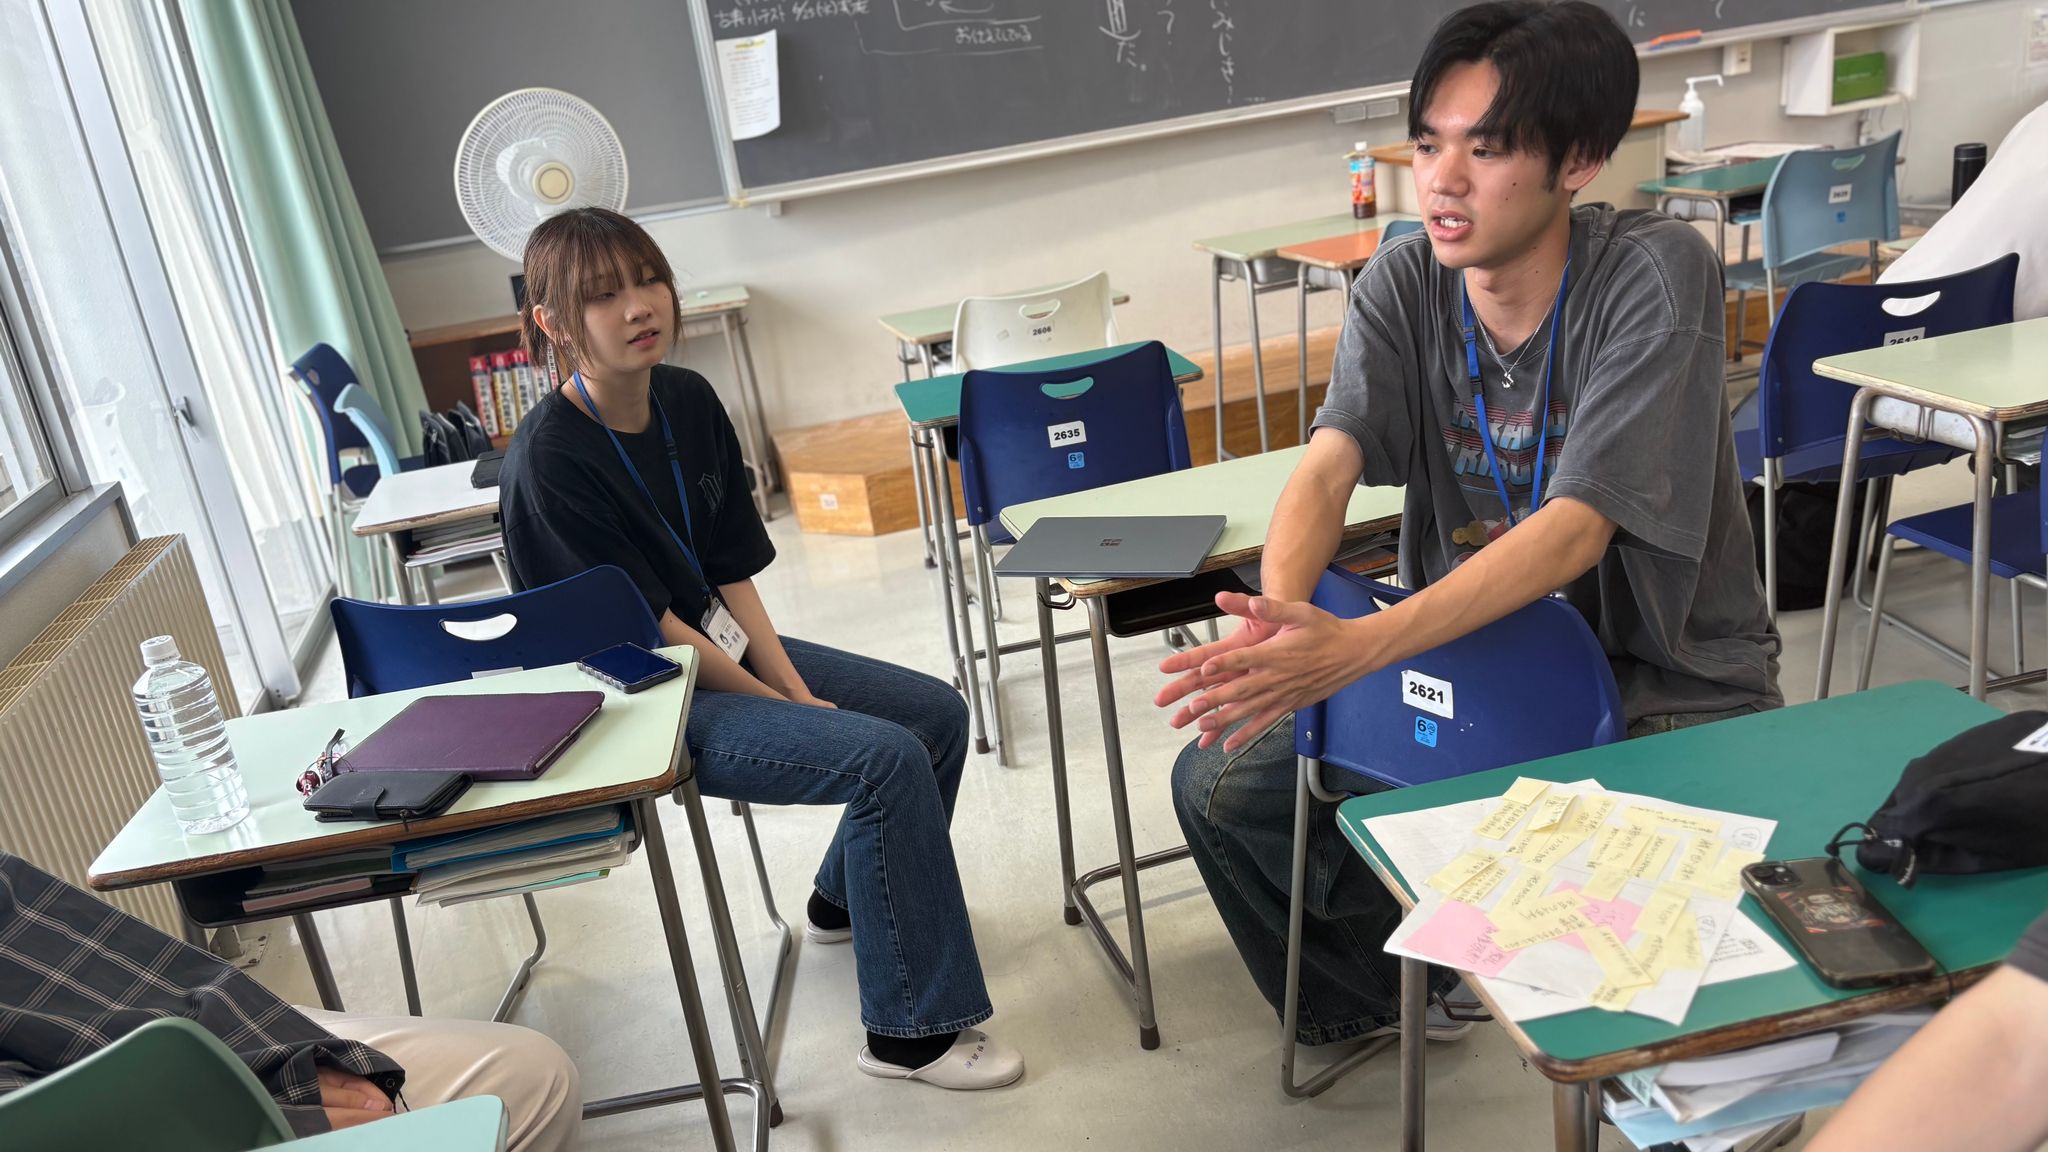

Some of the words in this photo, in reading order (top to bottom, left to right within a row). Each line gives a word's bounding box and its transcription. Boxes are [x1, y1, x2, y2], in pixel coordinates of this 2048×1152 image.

[1054, 428, 1080, 441] 2635
[1409, 681, 1444, 704] 2621
[1417, 719, 1427, 732] 6
